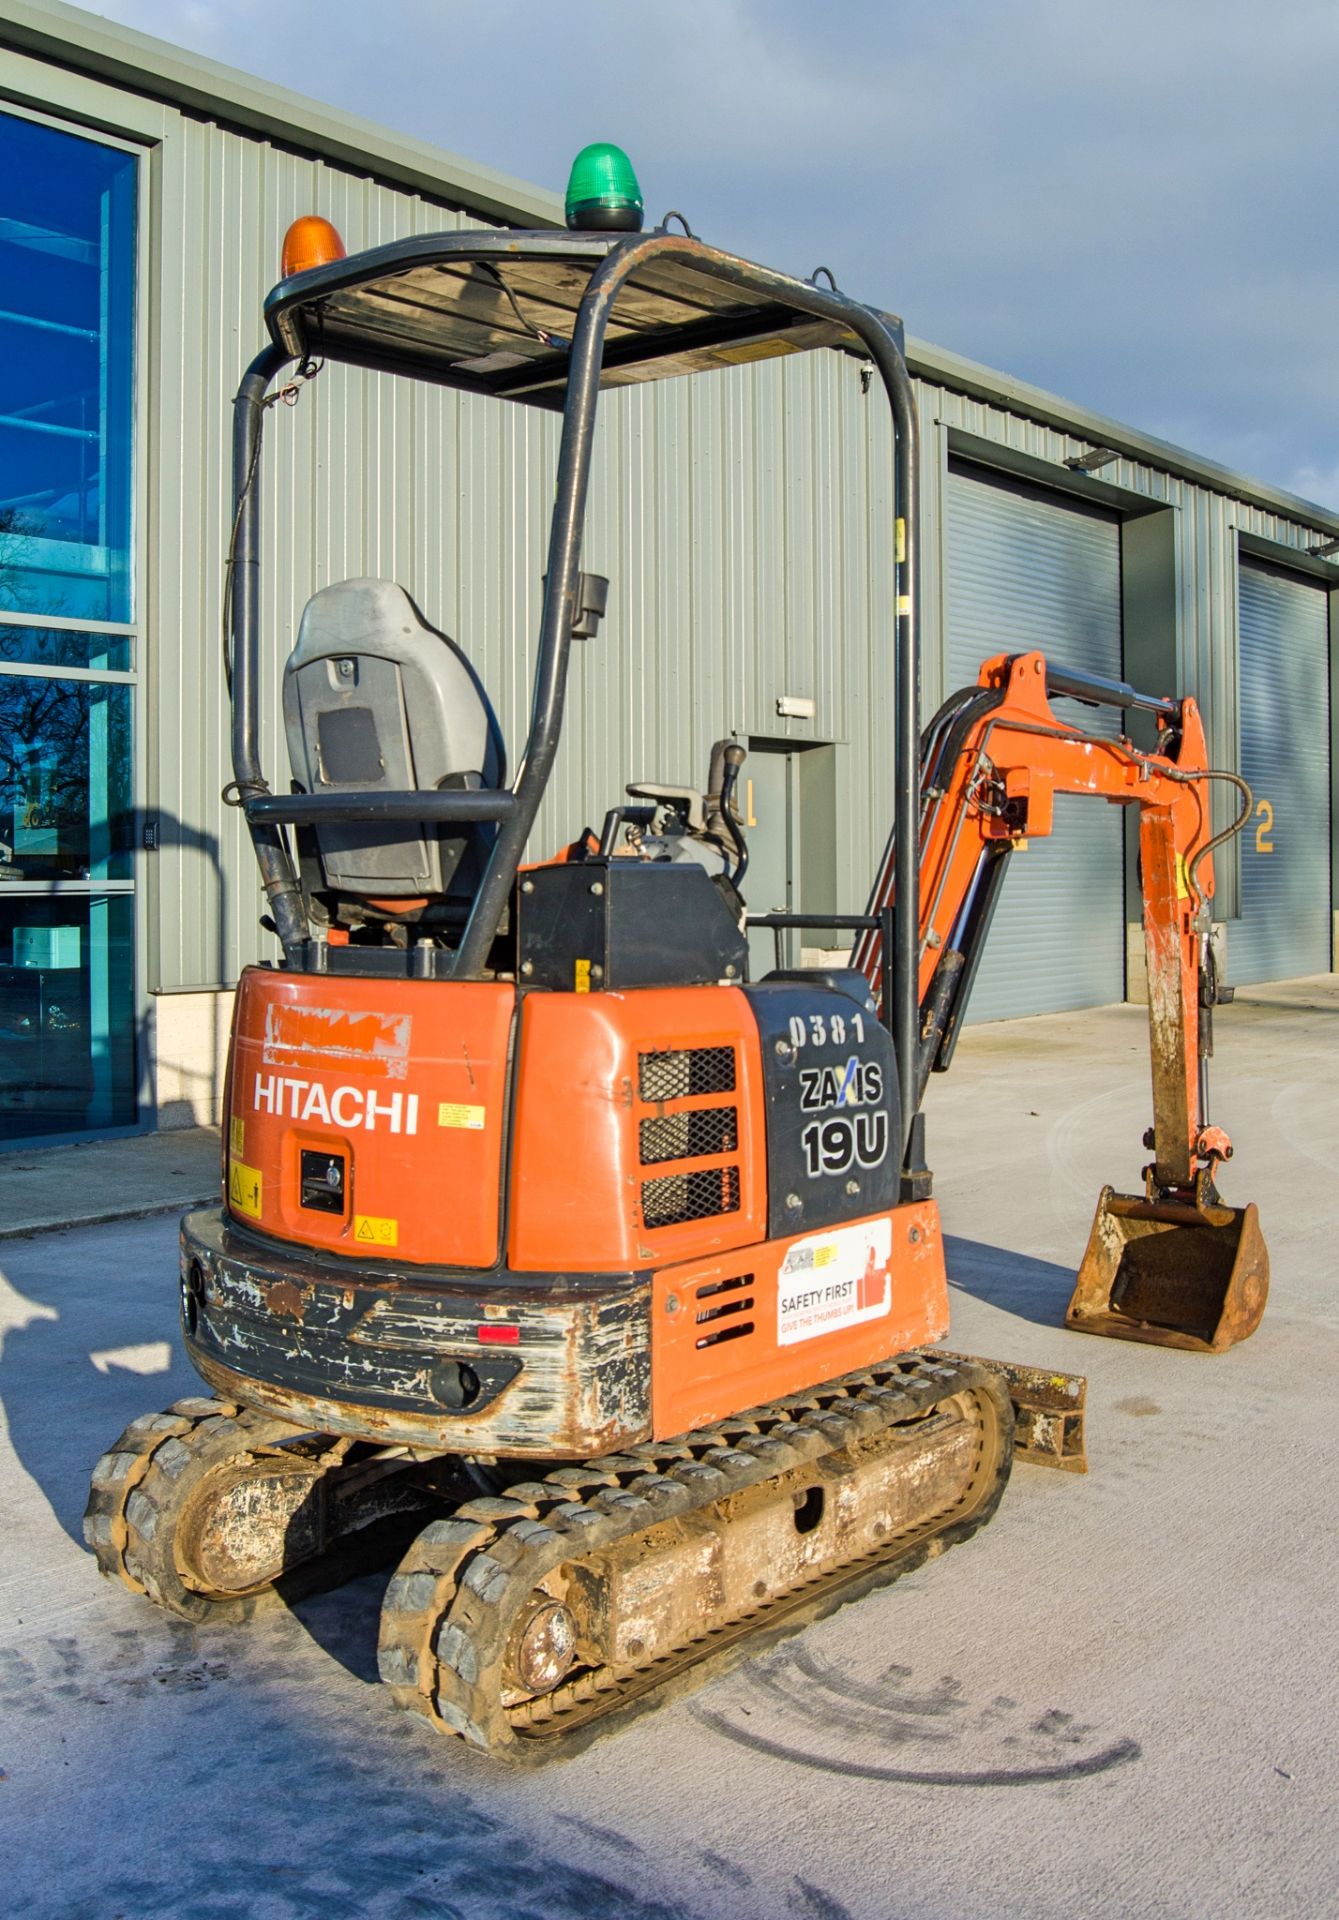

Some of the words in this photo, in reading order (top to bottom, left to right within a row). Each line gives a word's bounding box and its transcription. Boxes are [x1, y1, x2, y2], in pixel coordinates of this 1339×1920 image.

[1256, 799, 1273, 853] 2
[789, 1012, 865, 1047] 0381
[254, 1072, 418, 1135] HITACHI
[800, 1056, 882, 1111] ZAXIS
[802, 1111, 887, 1178] 19U
[781, 1288, 823, 1314] SAFETY
[825, 1280, 853, 1302] FIRST
[781, 1320, 798, 1333] GIVE
[799, 1315, 812, 1328] THE
[814, 1304, 842, 1323] THUMBS
